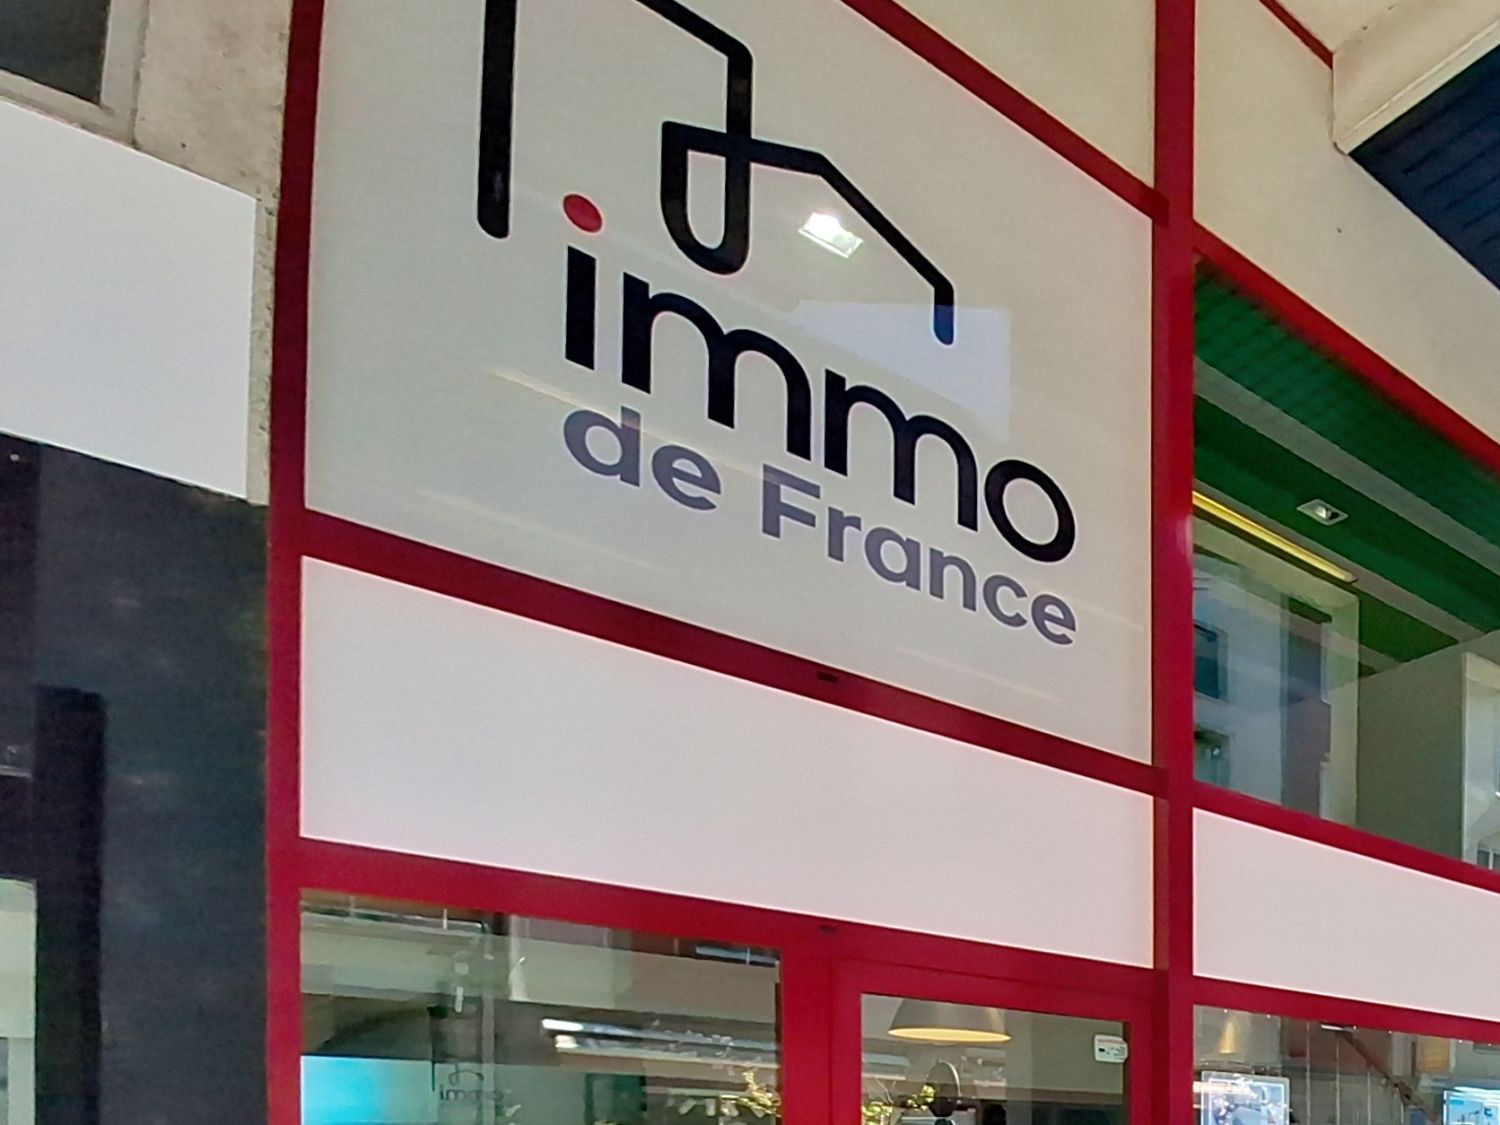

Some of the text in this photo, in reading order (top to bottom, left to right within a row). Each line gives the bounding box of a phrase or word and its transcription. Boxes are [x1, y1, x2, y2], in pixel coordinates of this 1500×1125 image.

[562, 406, 1078, 646] de France
[563, 193, 1077, 564] immo
